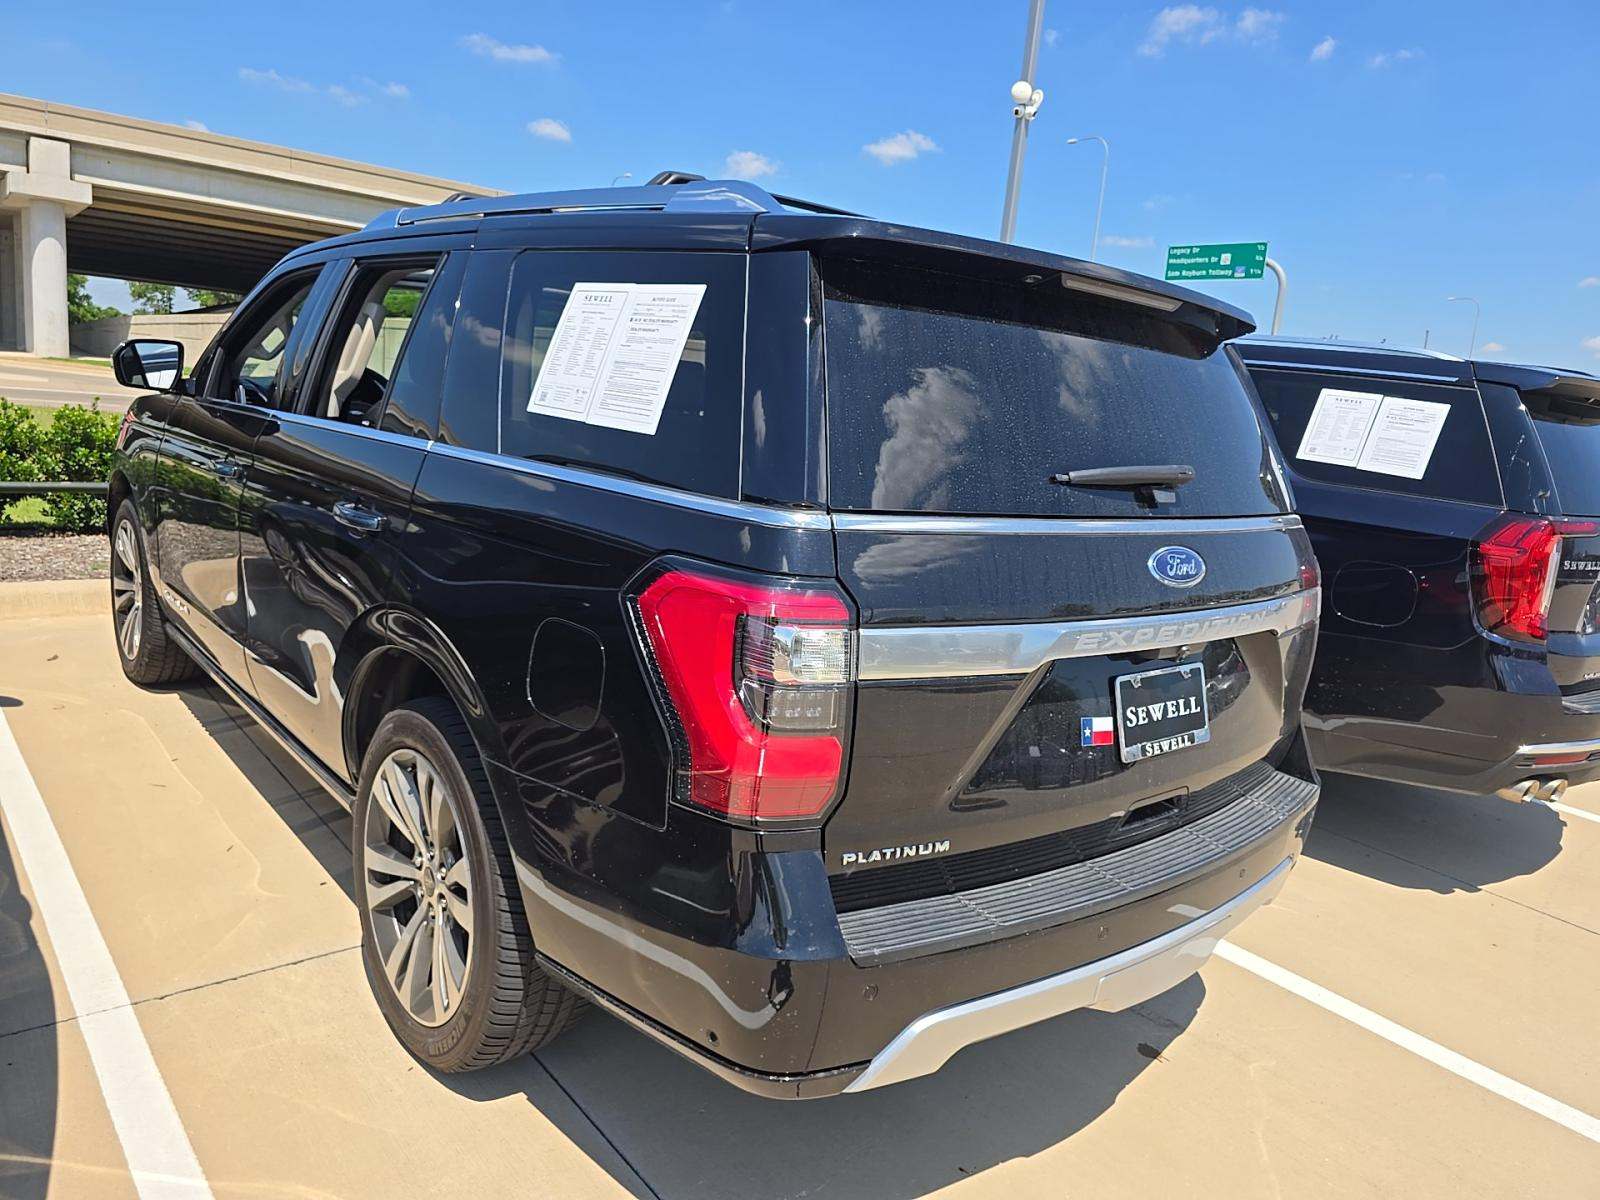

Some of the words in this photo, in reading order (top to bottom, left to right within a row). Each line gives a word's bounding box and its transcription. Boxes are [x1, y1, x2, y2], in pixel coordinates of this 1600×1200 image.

[1168, 257, 1209, 265] Headquarters
[1169, 247, 1191, 256] Legacy
[1192, 246, 1200, 254] Dr
[1181, 269, 1207, 277] Rayburn
[1208, 268, 1233, 277] Tollway
[1167, 554, 1197, 576] Ford
[1073, 611, 1265, 650] EXPEDITION
[1126, 696, 1201, 728] SEWELL
[1145, 735, 1192, 757] SEWELL
[842, 840, 950, 866] PLATINUM
